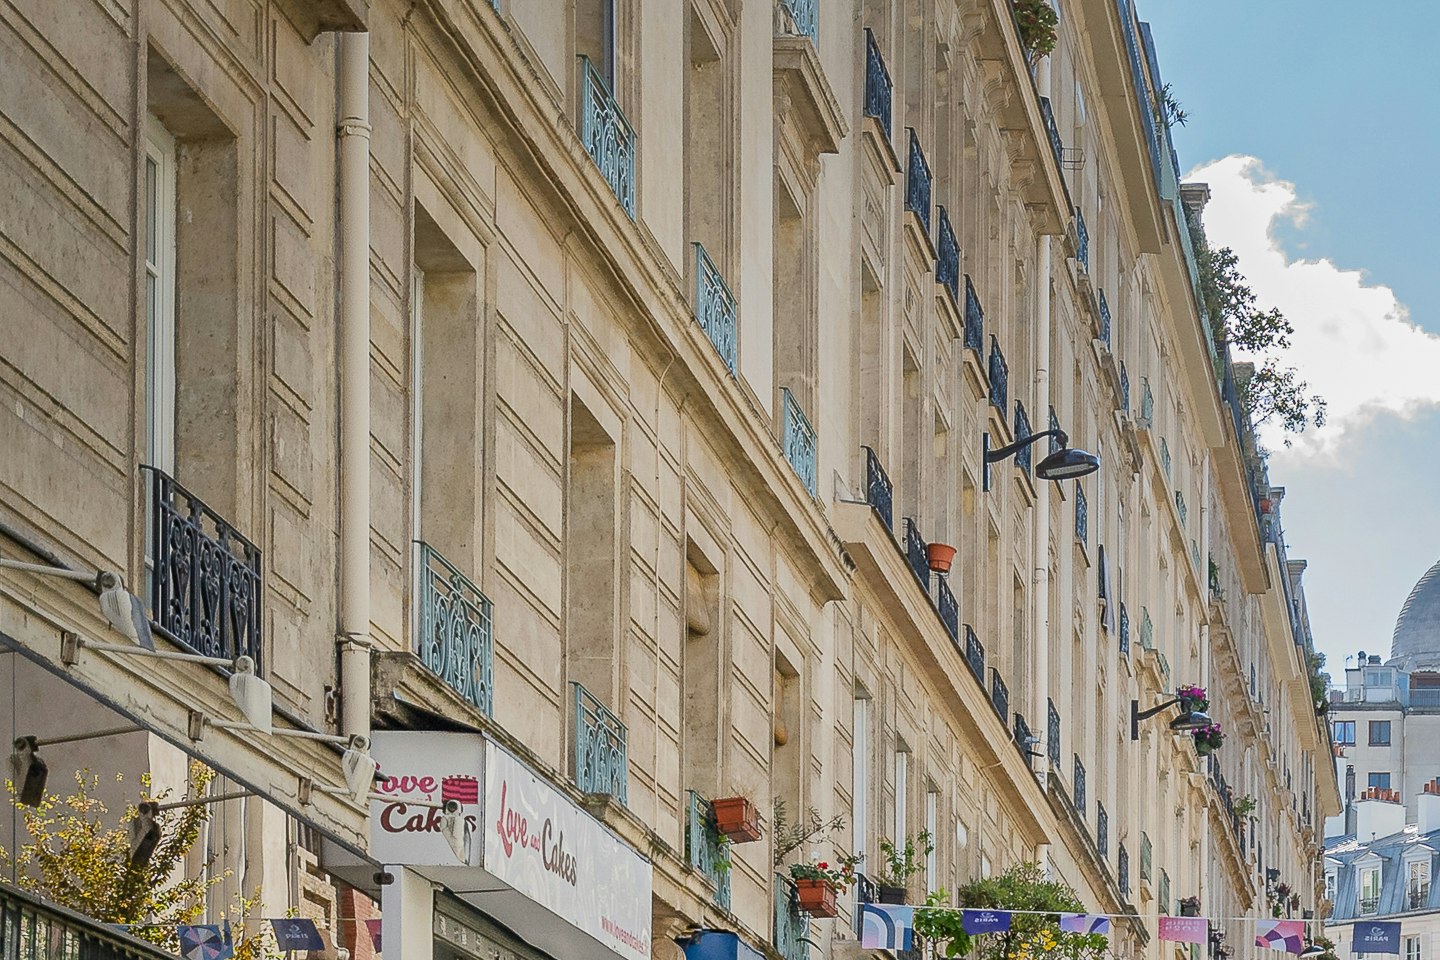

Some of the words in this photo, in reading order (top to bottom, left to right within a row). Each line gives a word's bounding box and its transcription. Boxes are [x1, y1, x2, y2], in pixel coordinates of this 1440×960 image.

[380, 802, 477, 833] Caks
[497, 780, 528, 858] Love
[542, 818, 577, 887] Cakes
